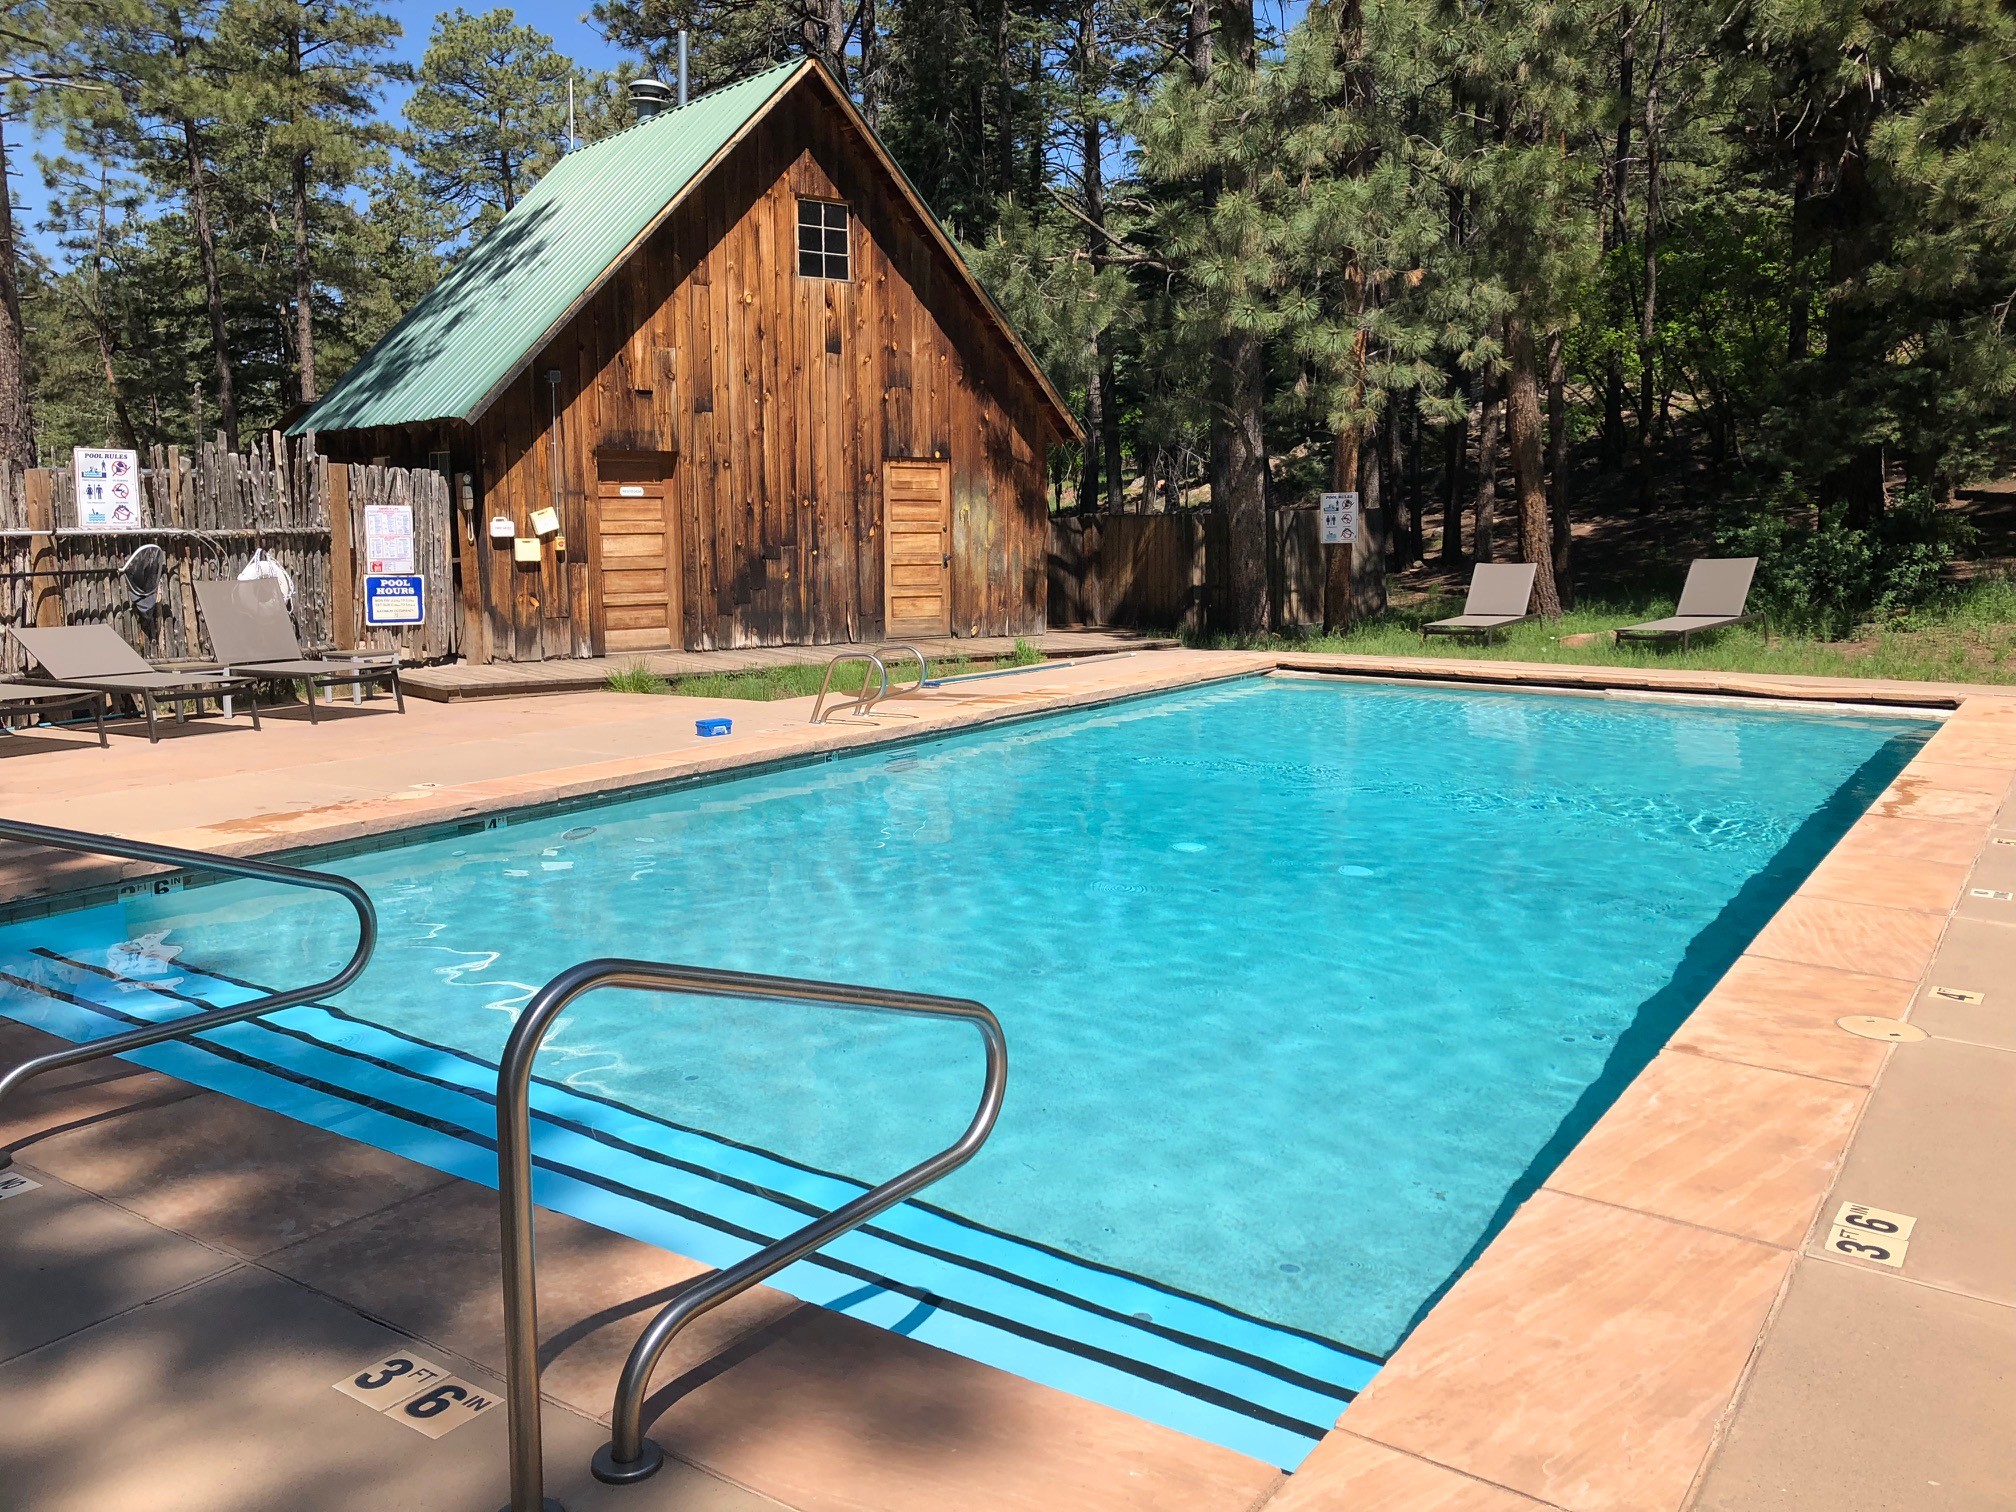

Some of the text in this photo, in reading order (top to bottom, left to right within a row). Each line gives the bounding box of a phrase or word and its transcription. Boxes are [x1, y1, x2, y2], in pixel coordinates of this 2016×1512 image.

[376, 587, 415, 595] HOURS
[380, 579, 411, 587] POOL
[154, 879, 170, 895] 6
[171, 877, 181, 885] IN
[1836, 1204, 1899, 1260] 3 FT 6 IN
[354, 1358, 493, 1419] 3 FT 6 IN
